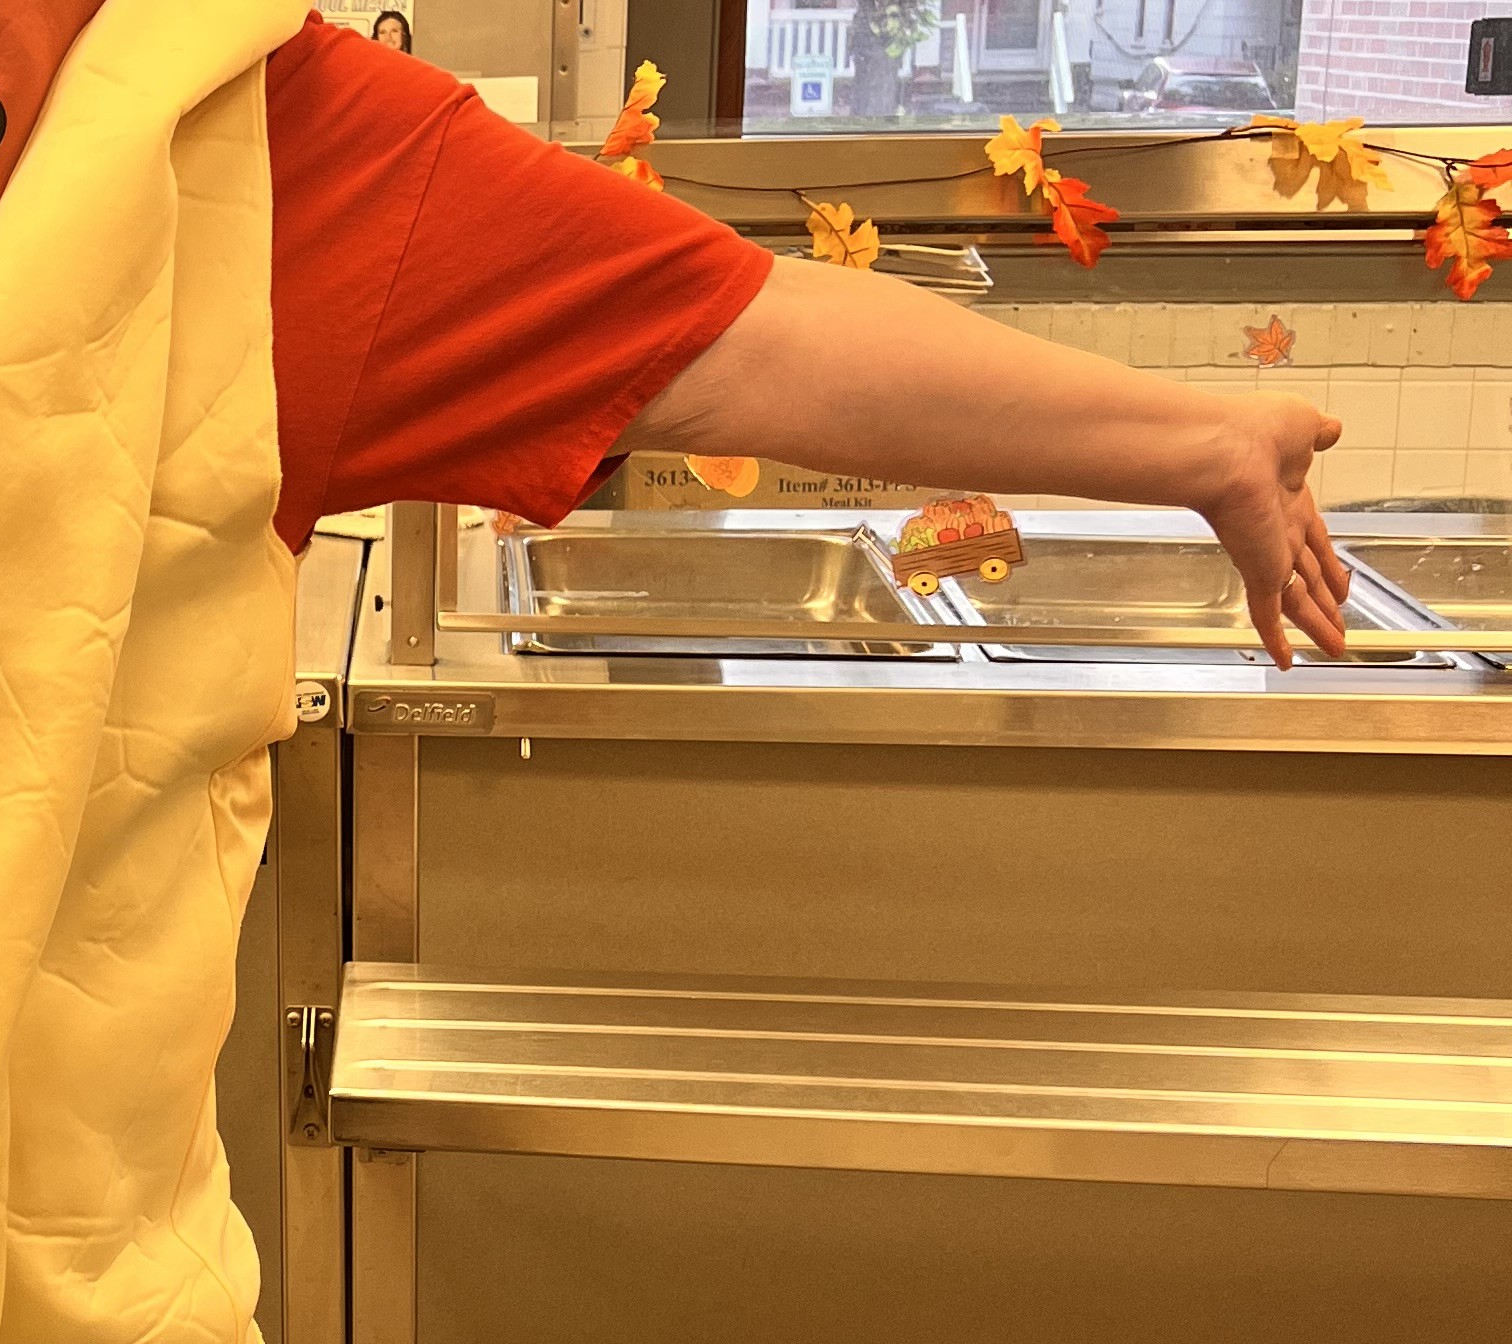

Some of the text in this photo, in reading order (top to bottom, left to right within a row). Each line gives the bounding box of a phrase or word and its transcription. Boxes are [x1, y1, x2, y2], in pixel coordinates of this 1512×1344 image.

[778, 477, 828, 493] Item#
[821, 497, 872, 508] Meal Kit
[394, 703, 476, 723] Delfield
